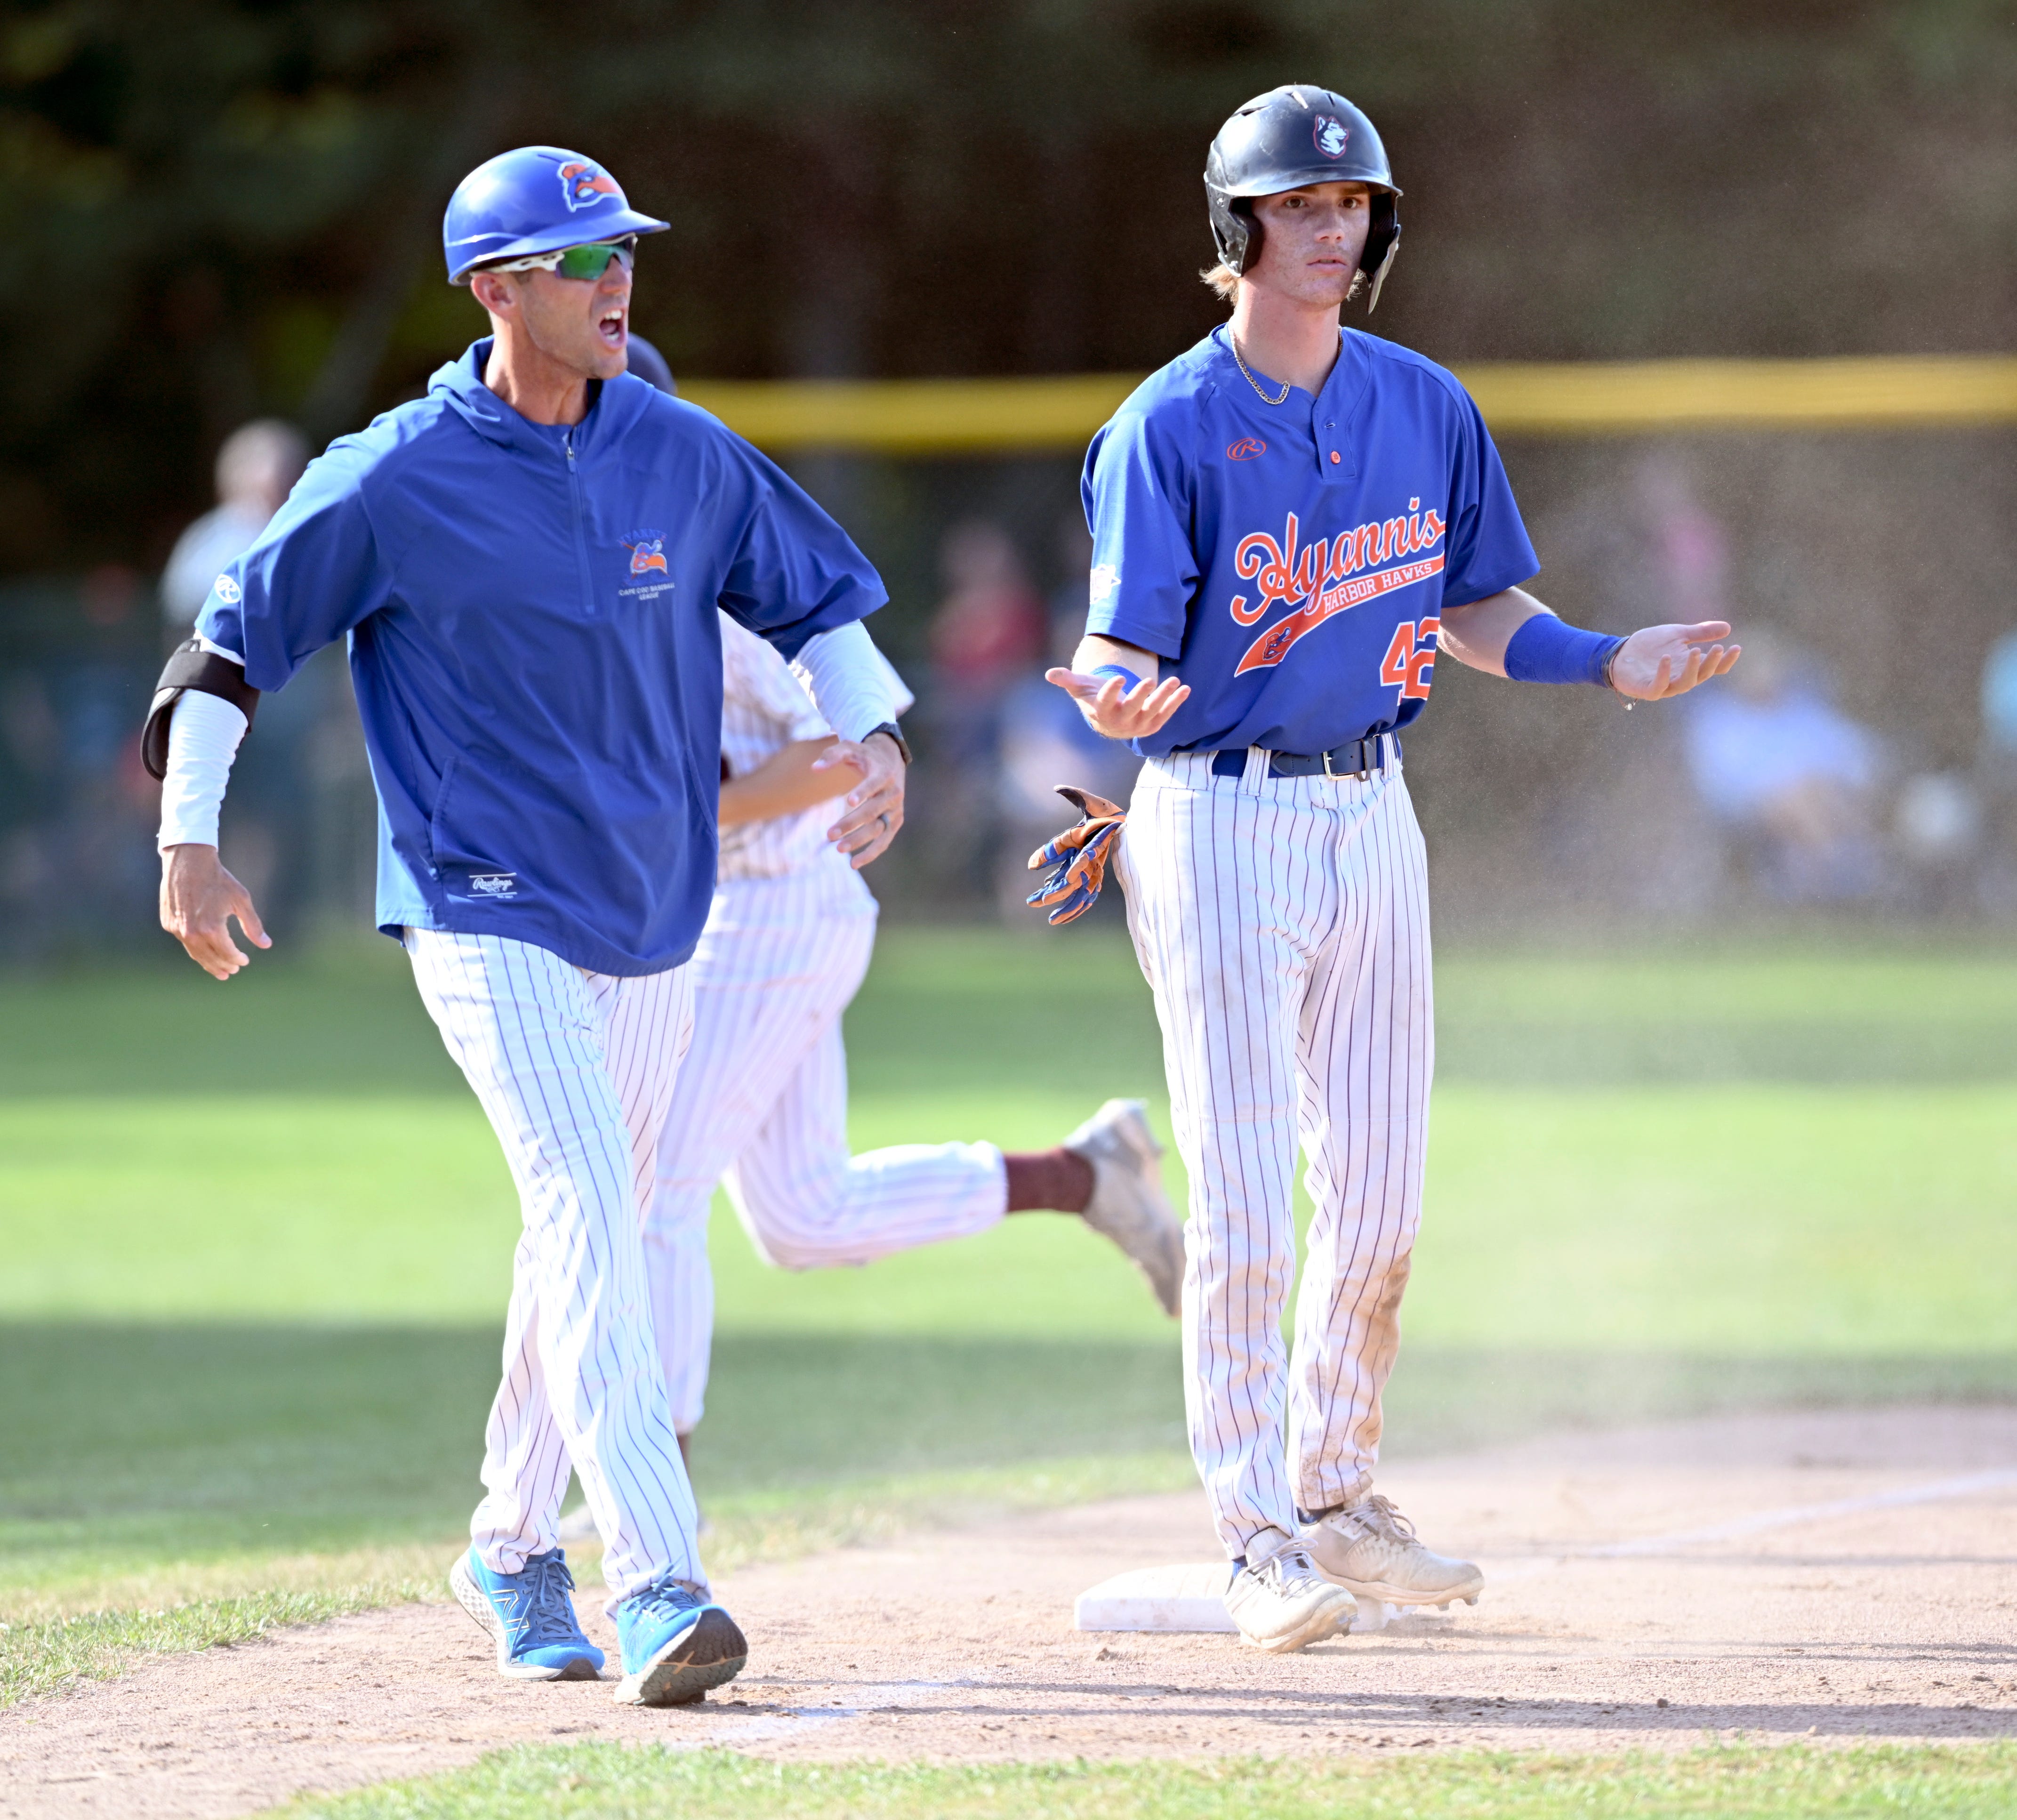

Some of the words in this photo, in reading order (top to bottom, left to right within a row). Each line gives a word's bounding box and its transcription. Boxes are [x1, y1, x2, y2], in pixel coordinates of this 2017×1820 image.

[1230, 497, 1446, 626] Hyannis
[1323, 580, 1377, 614] HARBOR
[1382, 563, 1432, 588] HAWKS
